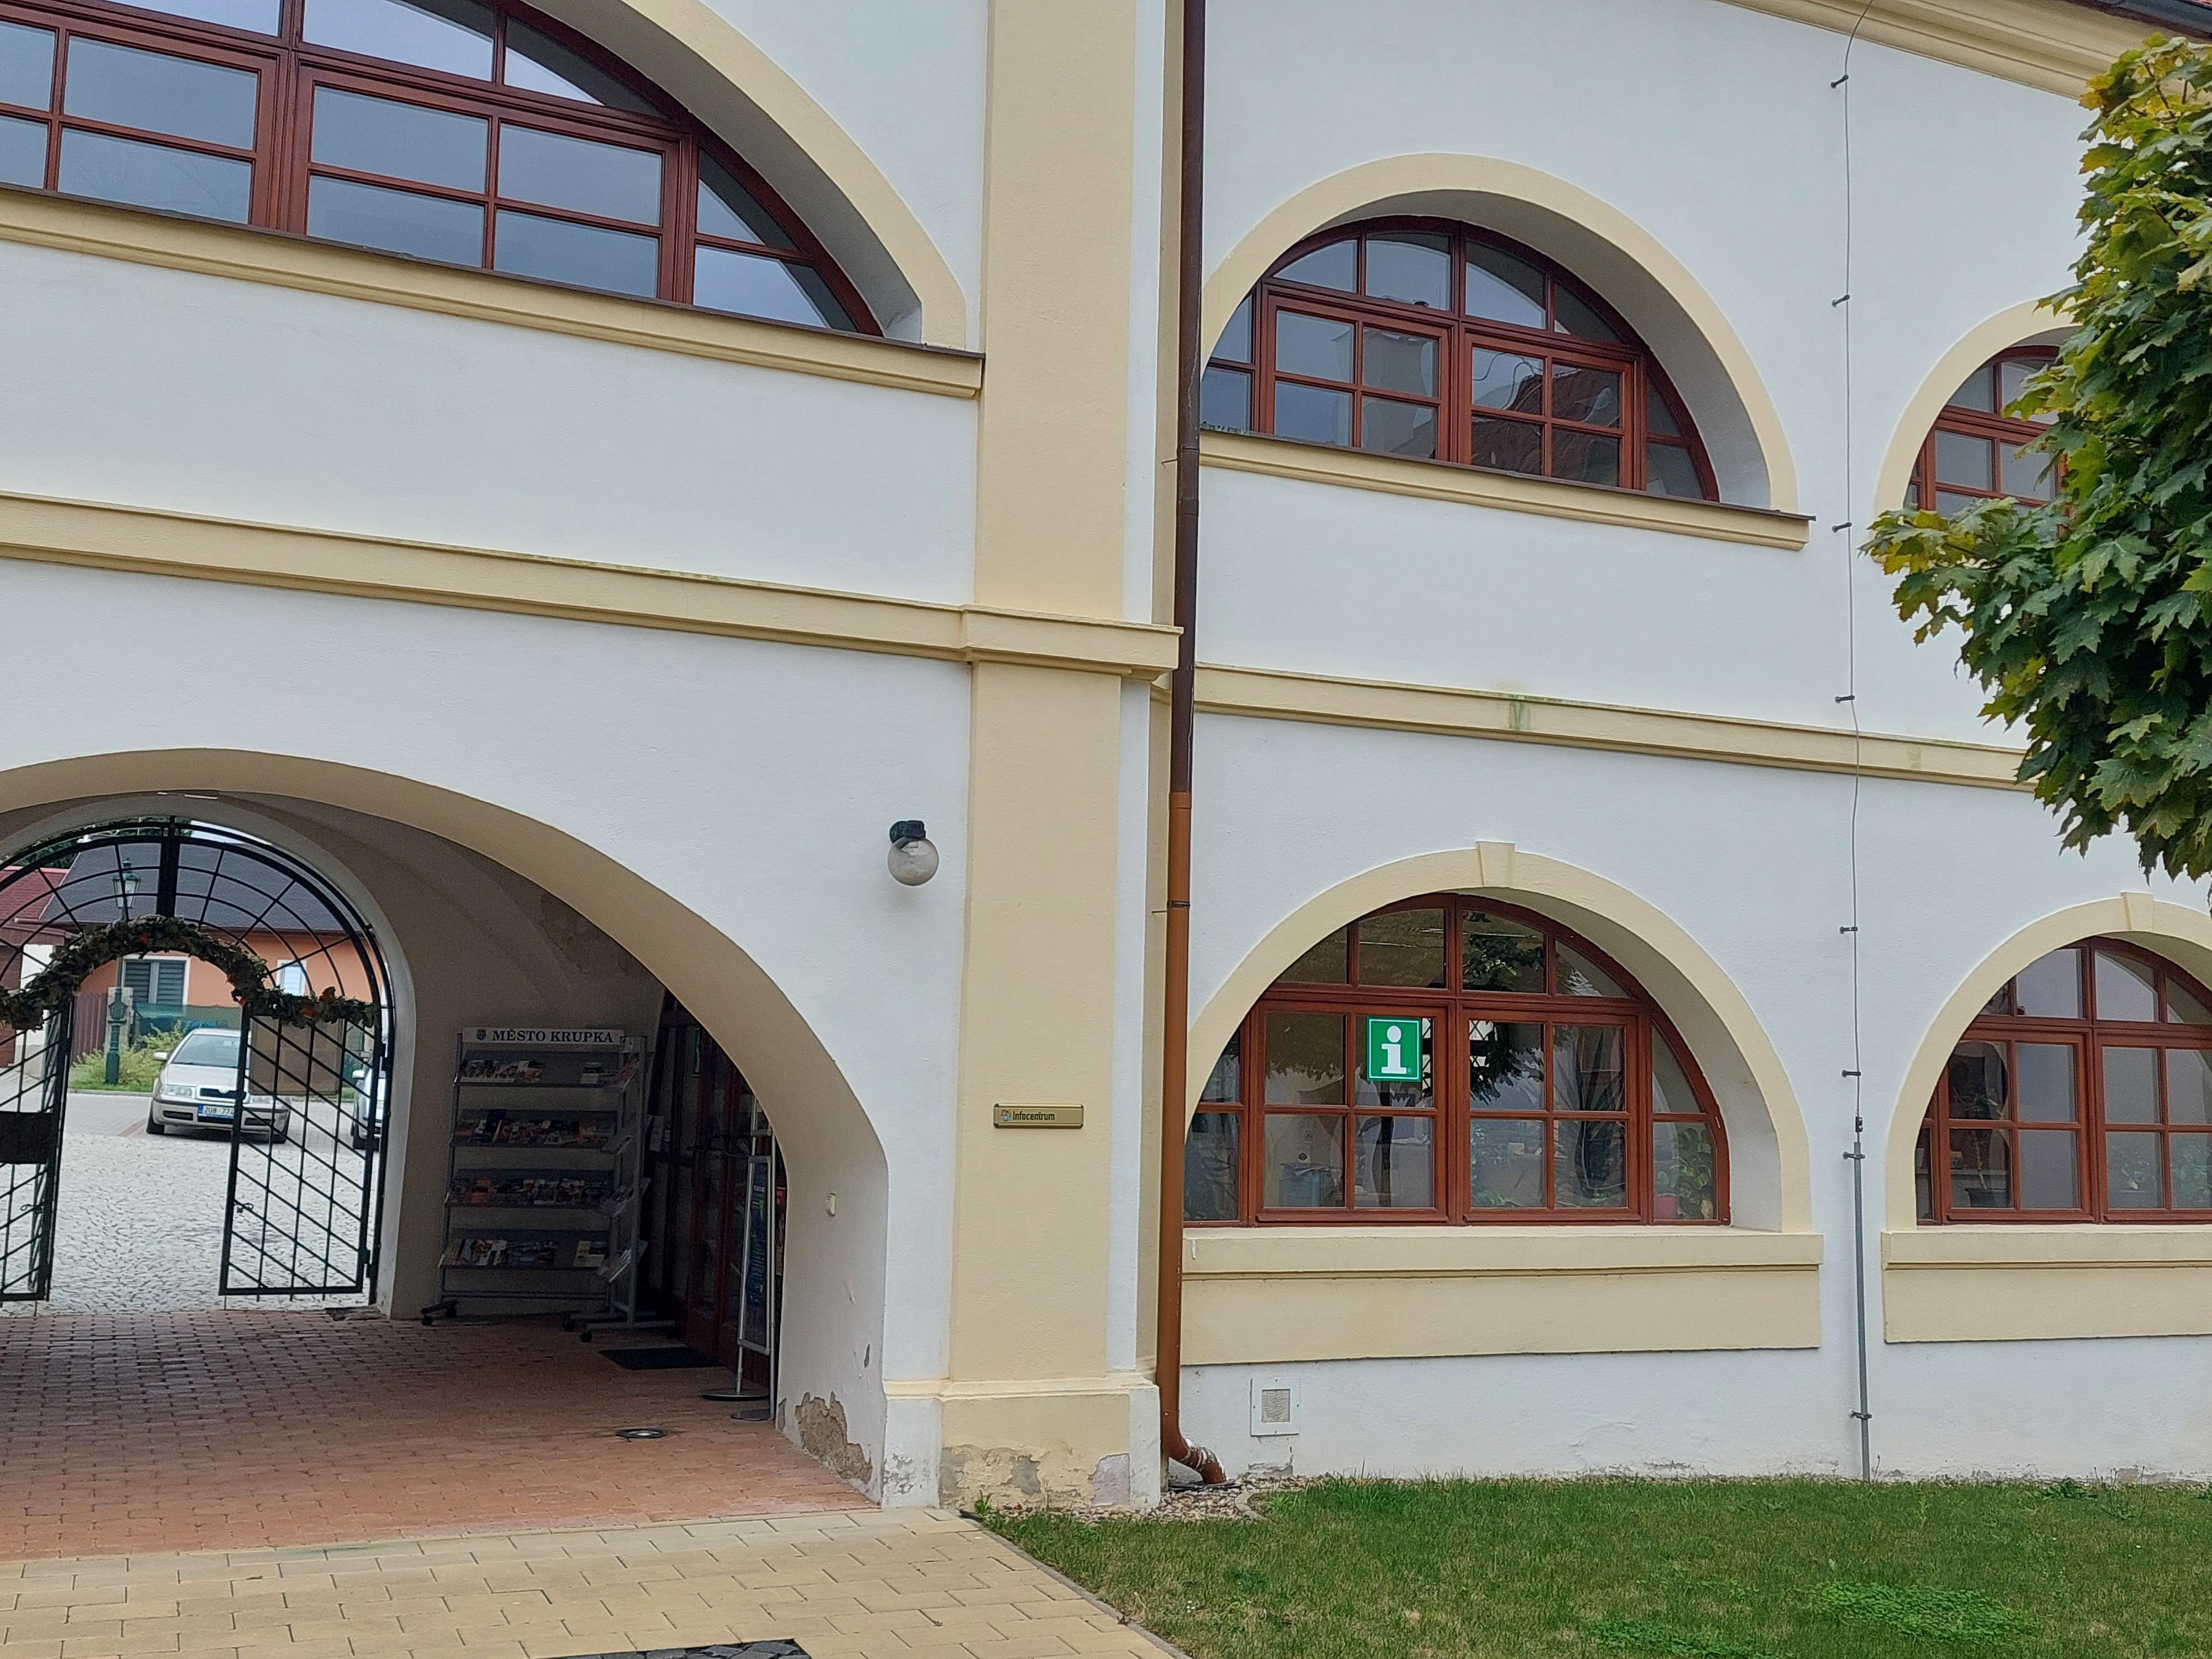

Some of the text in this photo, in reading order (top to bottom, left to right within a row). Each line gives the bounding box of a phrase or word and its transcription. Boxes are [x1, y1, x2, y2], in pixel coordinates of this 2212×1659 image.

[492, 1028, 613, 1043] MĚSTO KRUPKA
[1013, 1111, 1055, 1120] Infocentrum
